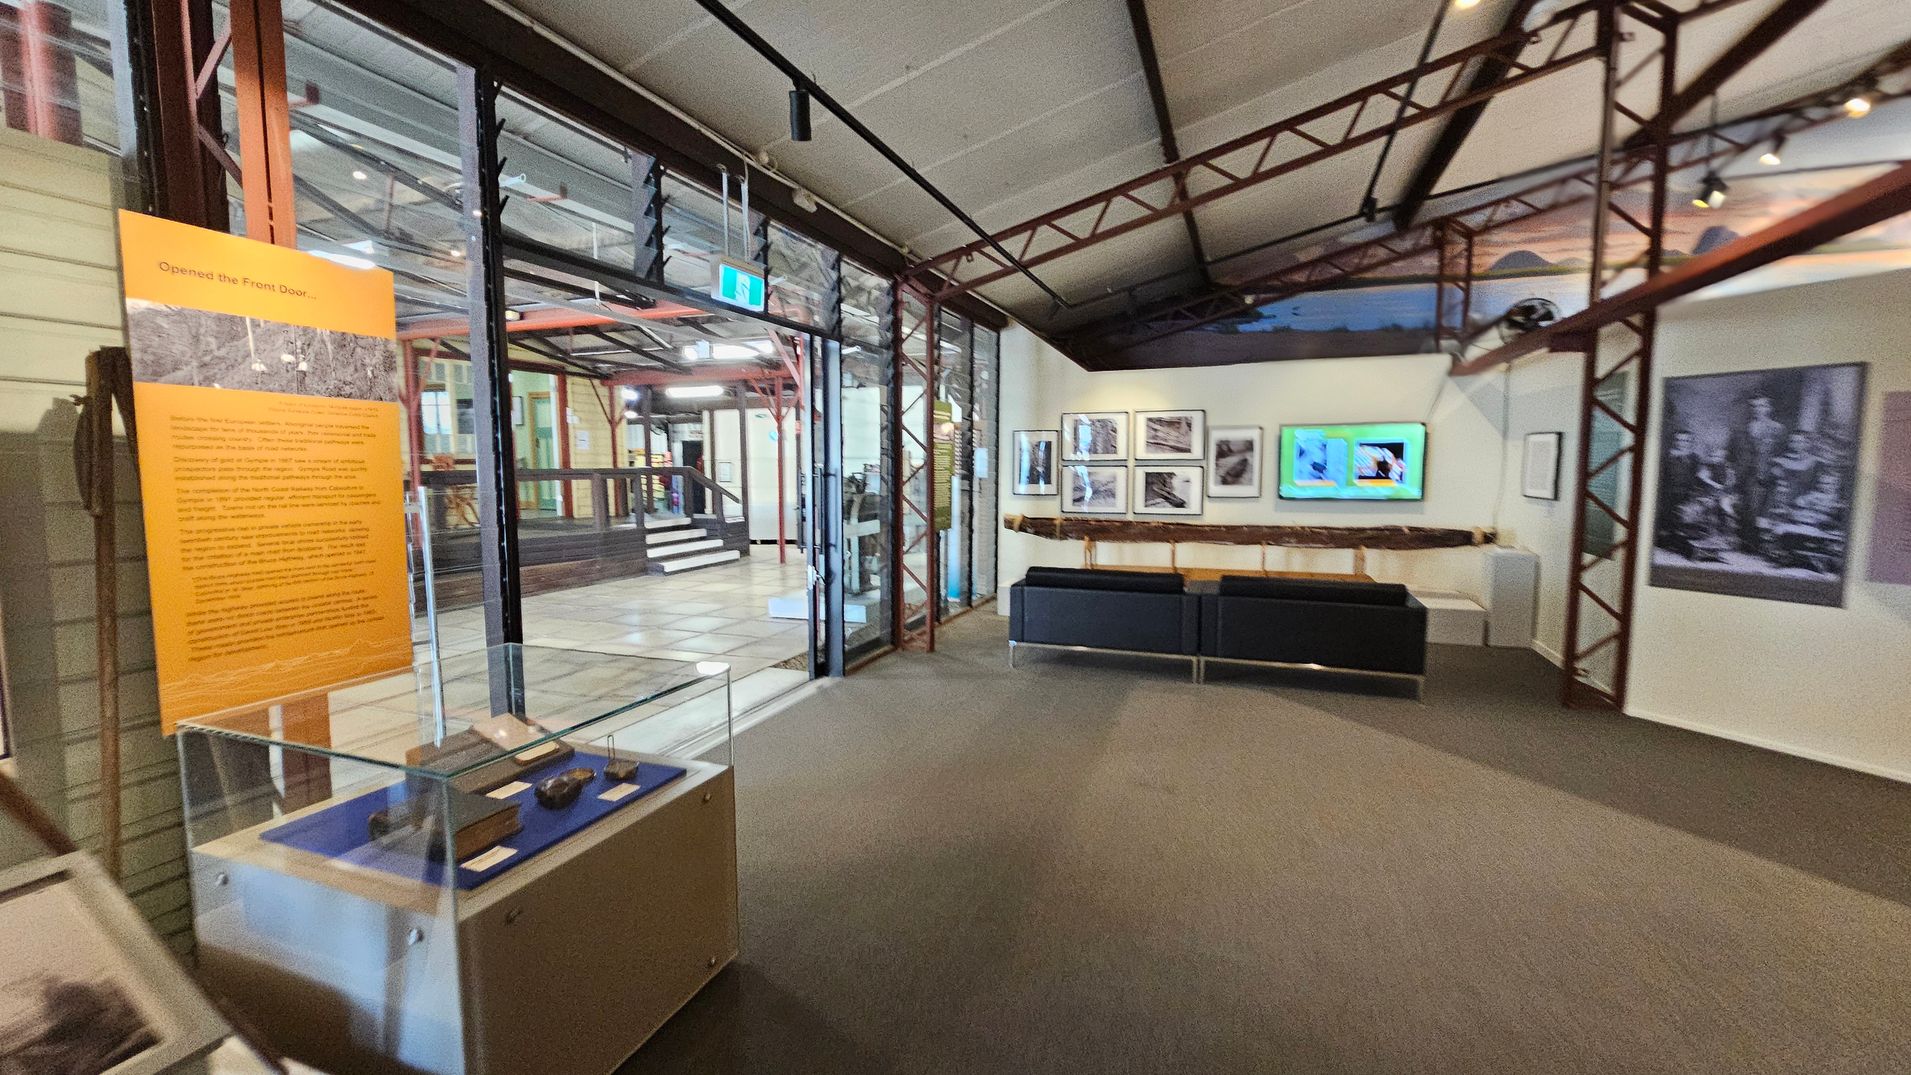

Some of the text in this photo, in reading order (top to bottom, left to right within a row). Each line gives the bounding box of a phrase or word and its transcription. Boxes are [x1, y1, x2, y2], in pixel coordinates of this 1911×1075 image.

[159, 261, 214, 281] Opened
[218, 272, 239, 285] the
[242, 277, 276, 291] Front
